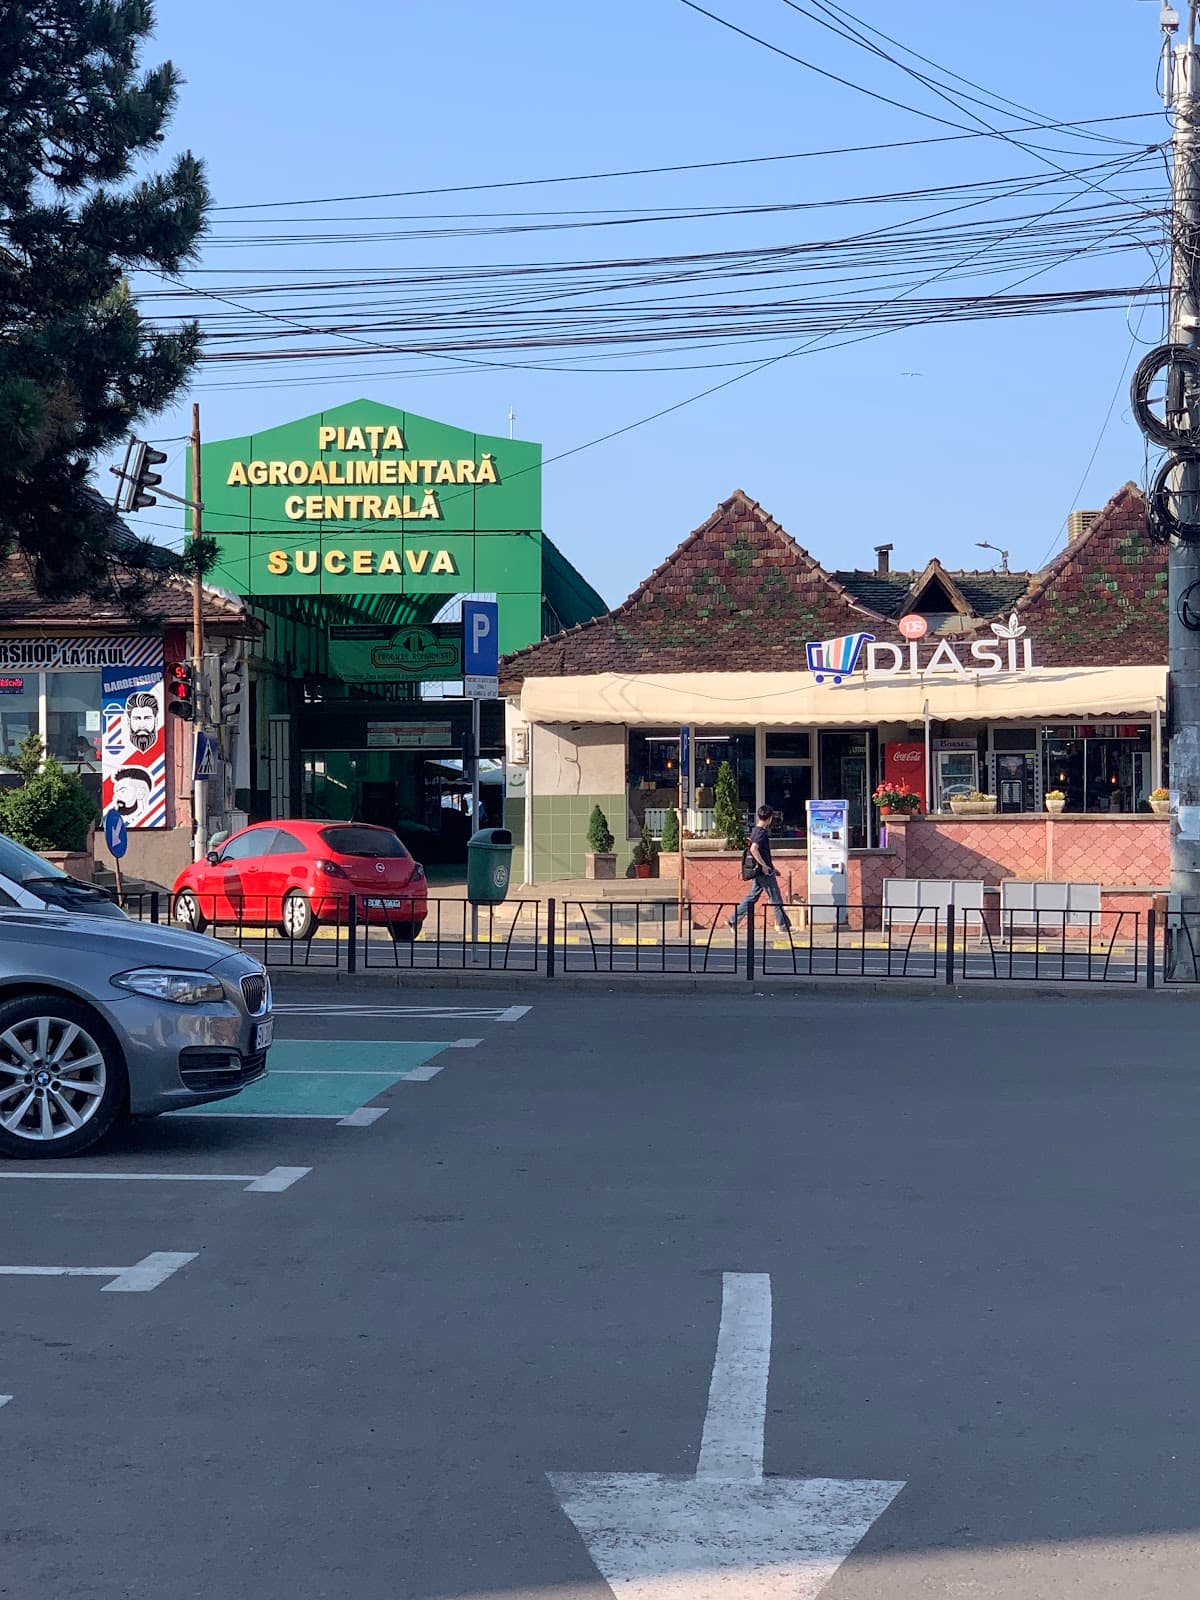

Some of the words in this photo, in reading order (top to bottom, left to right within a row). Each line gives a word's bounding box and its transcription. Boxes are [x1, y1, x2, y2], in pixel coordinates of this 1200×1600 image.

[319, 426, 404, 456] PIAȚA
[227, 453, 497, 486] AGROALIMENTARĂ
[285, 489, 440, 519] CENTRALĂ
[267, 550, 455, 575] SUCEAVA
[472, 613, 490, 654] P
[62, 648, 80, 665] LA
[86, 648, 125, 665] RAUL
[867, 638, 1043, 681] DIASIL
[103, 671, 163, 693] BARBERSHOP
